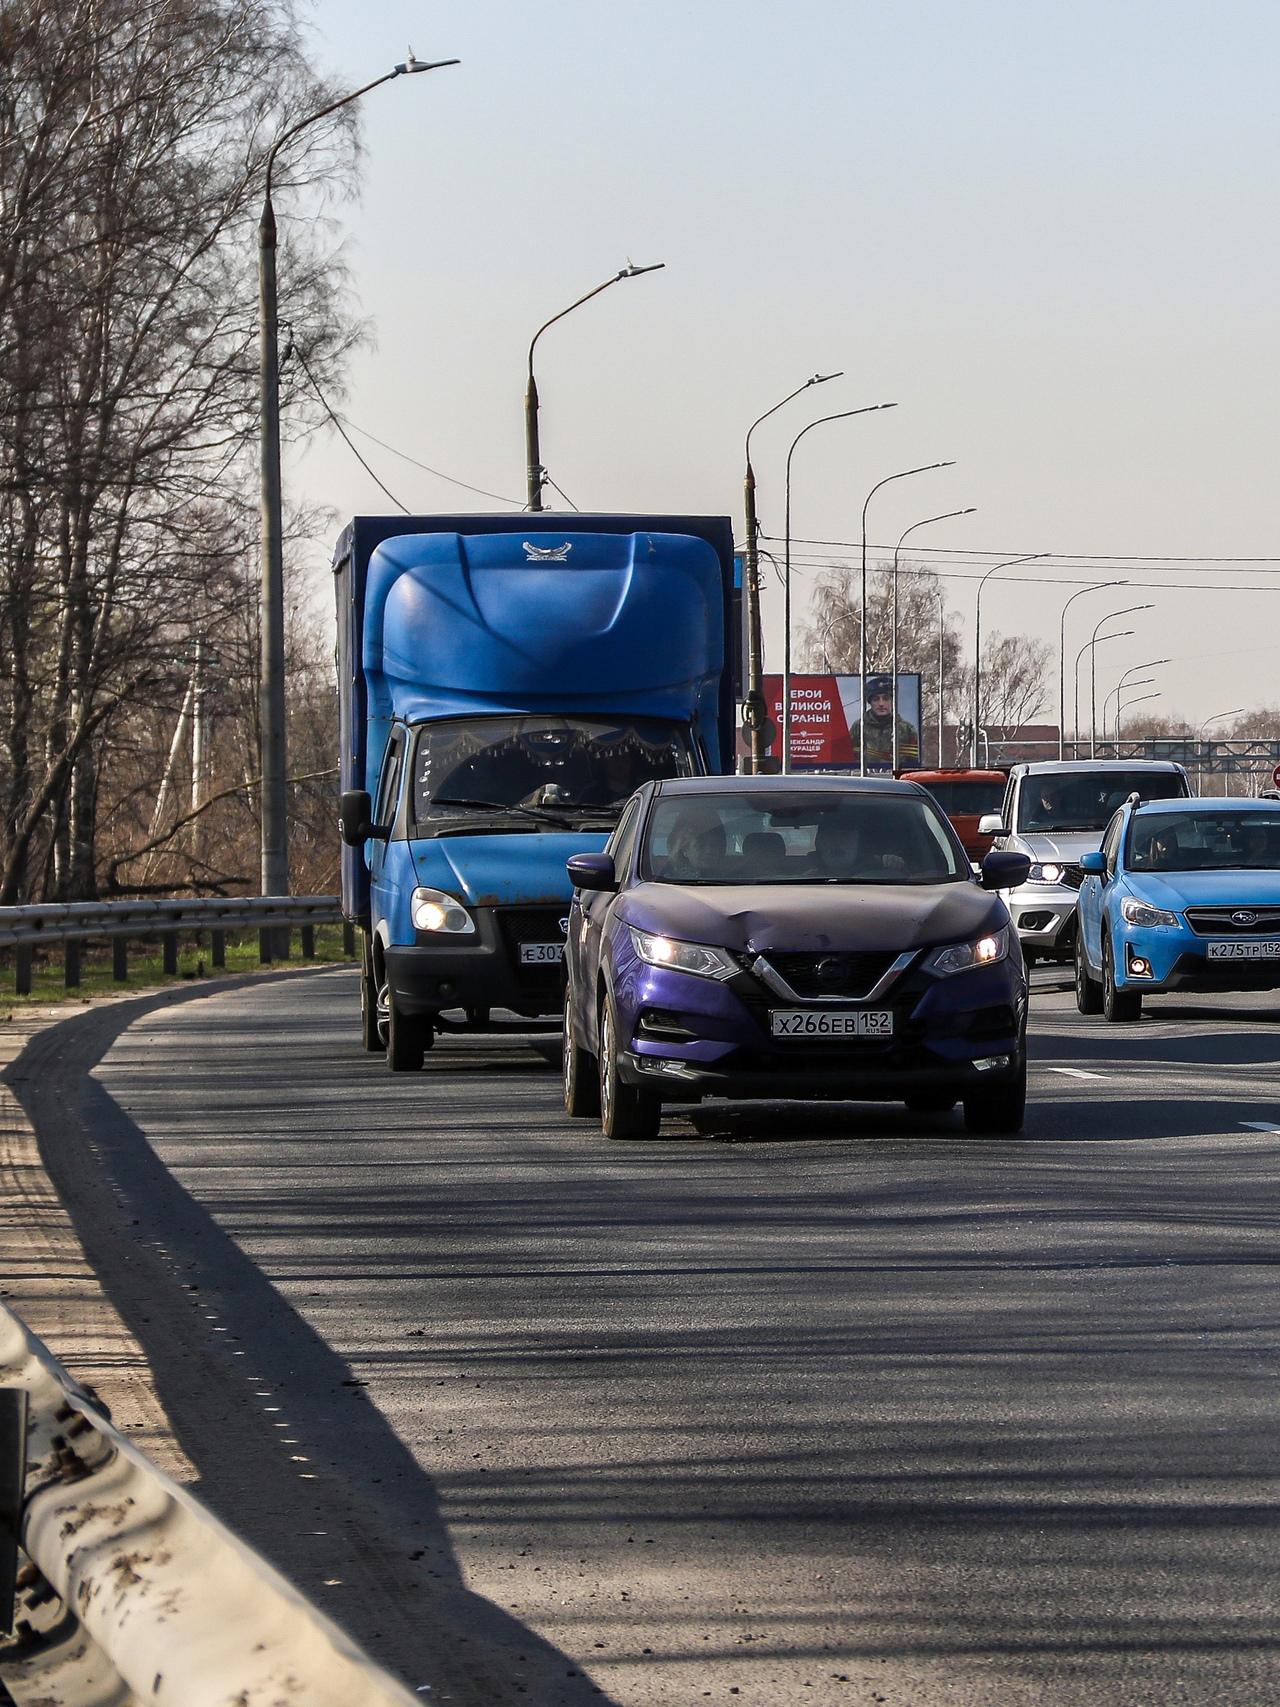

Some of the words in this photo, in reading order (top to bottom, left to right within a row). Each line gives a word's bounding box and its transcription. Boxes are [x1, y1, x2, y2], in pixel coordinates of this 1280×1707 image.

[790, 690, 822, 698] ЕРОИ
[775, 700, 831, 710] ВЛИКОЙ
[776, 714, 830, 722] СРАНЫ!
[1211, 944, 1259, 956] К275ТР
[1262, 943, 1280, 952] 152
[779, 1014, 855, 1033] Х266ЕВ
[860, 1013, 889, 1027] 152
